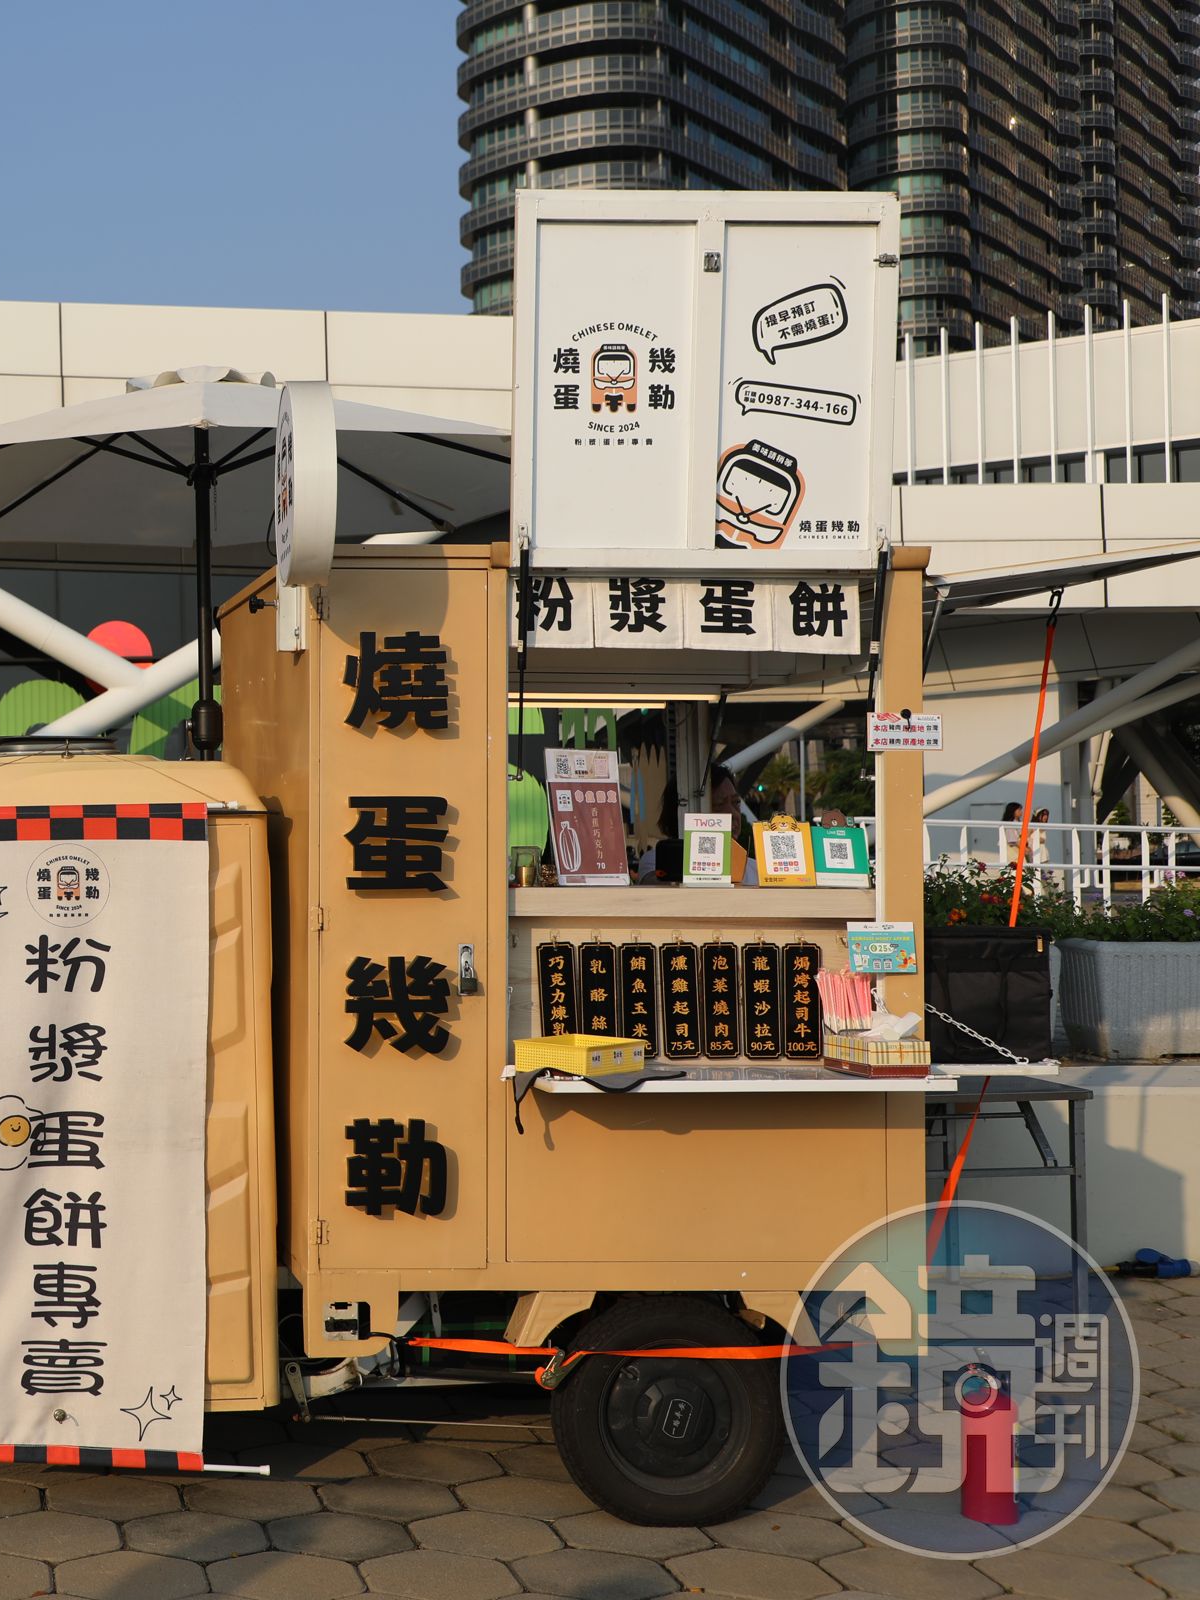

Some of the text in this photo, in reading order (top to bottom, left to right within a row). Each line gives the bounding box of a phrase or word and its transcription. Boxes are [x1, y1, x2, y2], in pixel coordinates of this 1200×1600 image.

[764, 301, 815, 328] 提早預訂
[778, 313, 835, 340] 不需燒蛋!
[572, 322, 658, 342] CHINESE OMELET
[758, 392, 848, 416] 0987-344-166
[588, 421, 640, 433] SINCE 2024
[799, 520, 860, 532] 燒蛋幾勒
[515, 577, 848, 638] 粉漿蛋餅
[46, 855, 90, 866] CHINESE OMELET
[344, 631, 449, 1217] 燒蛋幾勒
[590, 959, 609, 1030] 乳酪絲
[630, 957, 648, 1037] 鮪魚玉米
[670, 955, 690, 1038] 燻雞起司
[712, 955, 730, 1038] 泡菜燒肉
[752, 956, 773, 1038] 龍蝦沙拉
[793, 956, 811, 1038] 焗烤起司牛
[671, 1041, 695, 1050] 75元
[710, 1041, 733, 1050] 85元
[751, 1041, 775, 1050] 90元
[787, 1041, 817, 1051] 100元
[21, 934, 112, 1396] 粉漿蛋餅專賣
